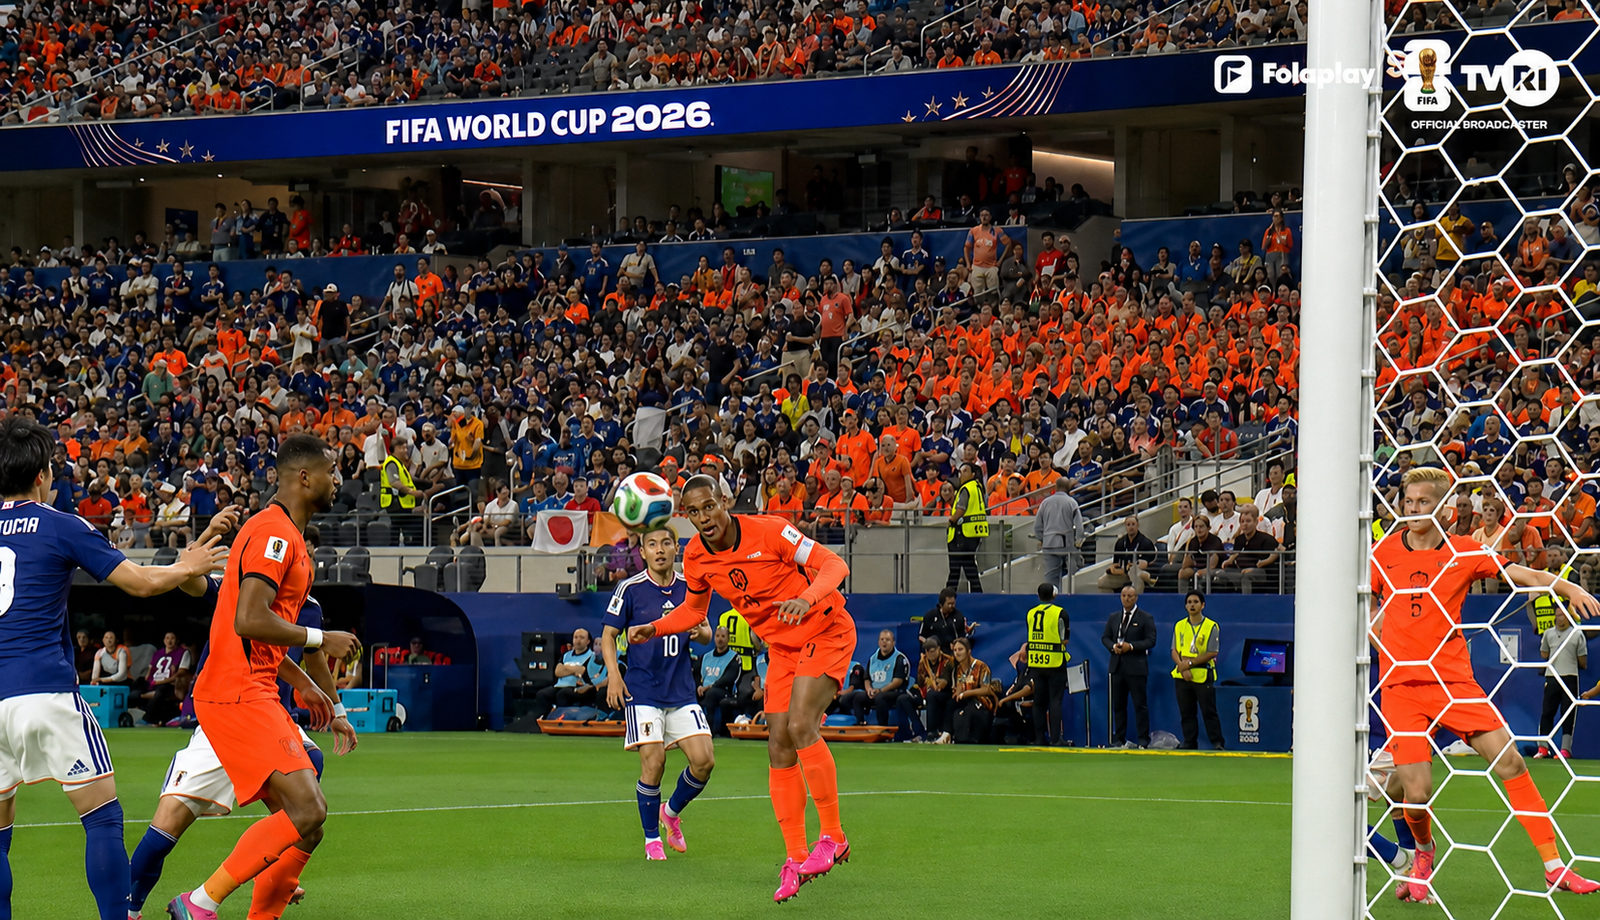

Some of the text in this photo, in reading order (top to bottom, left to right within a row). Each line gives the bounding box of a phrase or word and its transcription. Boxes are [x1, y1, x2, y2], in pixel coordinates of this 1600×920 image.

[386, 117, 442, 144] FIFA
[446, 112, 546, 141] WORLD
[550, 108, 606, 136] CUP
[662, 634, 679, 657] 10
